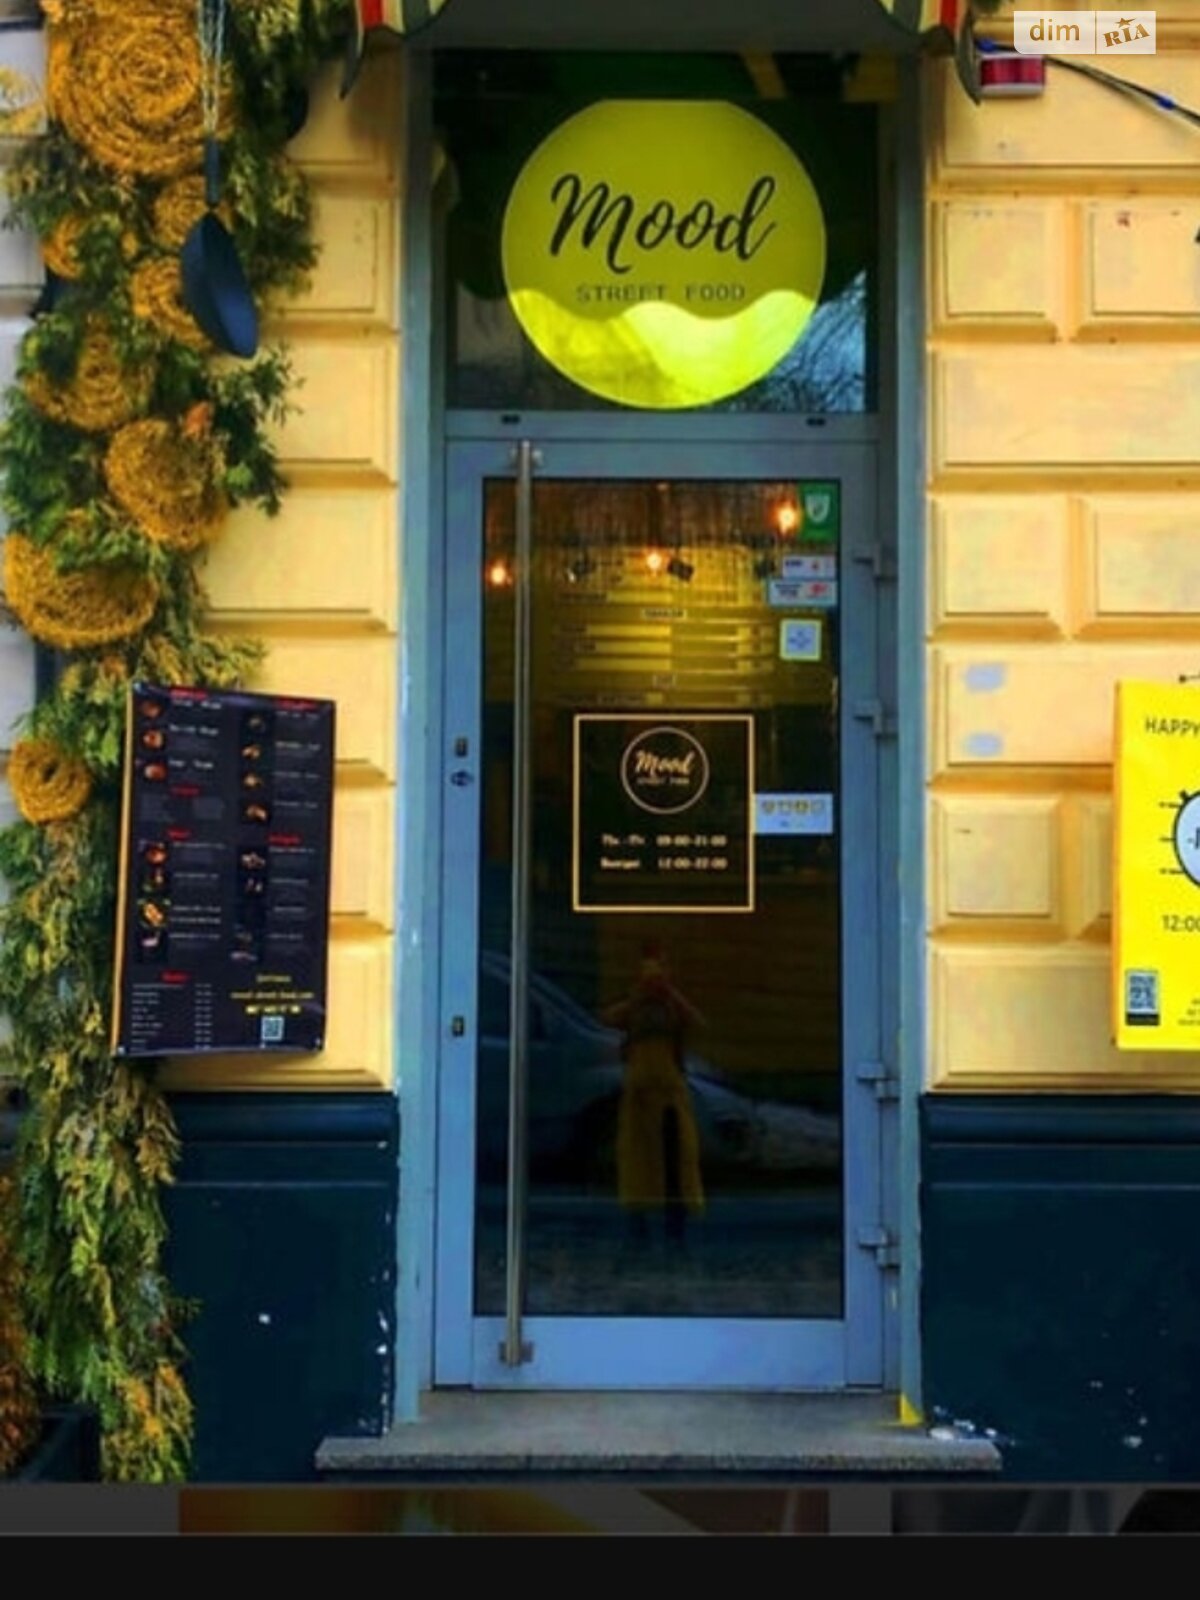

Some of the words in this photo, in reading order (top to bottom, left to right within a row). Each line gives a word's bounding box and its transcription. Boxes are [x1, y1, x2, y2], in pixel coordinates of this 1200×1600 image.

[550, 173, 777, 275] Mood
[576, 284, 667, 302] STREET
[685, 284, 746, 302] FOOD
[1144, 716, 1200, 738] HAPPY
[634, 750, 696, 777] Mood
